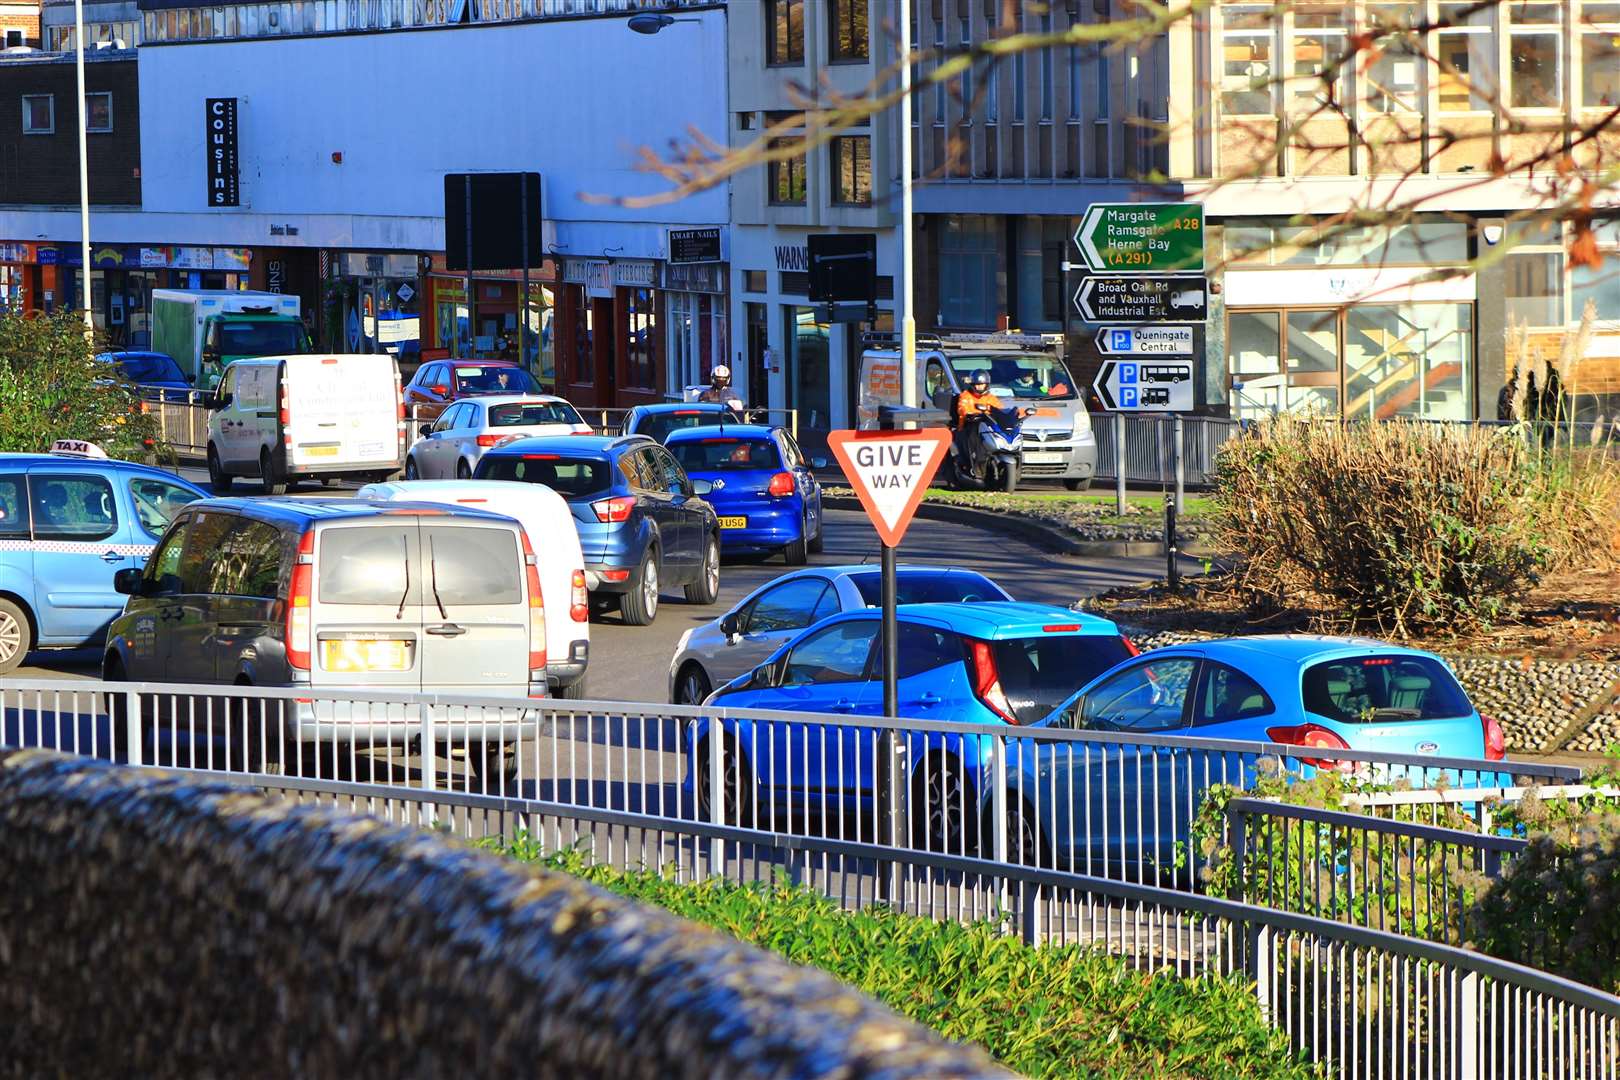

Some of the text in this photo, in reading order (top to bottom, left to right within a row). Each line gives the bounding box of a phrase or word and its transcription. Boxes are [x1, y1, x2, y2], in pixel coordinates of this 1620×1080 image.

[213, 102, 225, 203] Cousins
[1108, 210, 1156, 224] Margate
[672, 230, 718, 240] SMART NAILS
[1108, 224, 1164, 238] Ramsgate
[1108, 238, 1170, 251] Herne Bay
[1098, 282, 1168, 292] Broad Oak Rd
[1098, 294, 1162, 304] and Vauxhall
[1098, 306, 1144, 316] Industrial
[1114, 332, 1126, 349] P
[1134, 330, 1190, 341] Queningate
[1140, 342, 1177, 352] Central
[1123, 366, 1134, 382] P
[1124, 389, 1135, 406] P
[56, 441, 88, 452] TAXI
[856, 445, 922, 468] GIVE
[872, 474, 912, 488] WAY
[726, 518, 744, 527] USG
